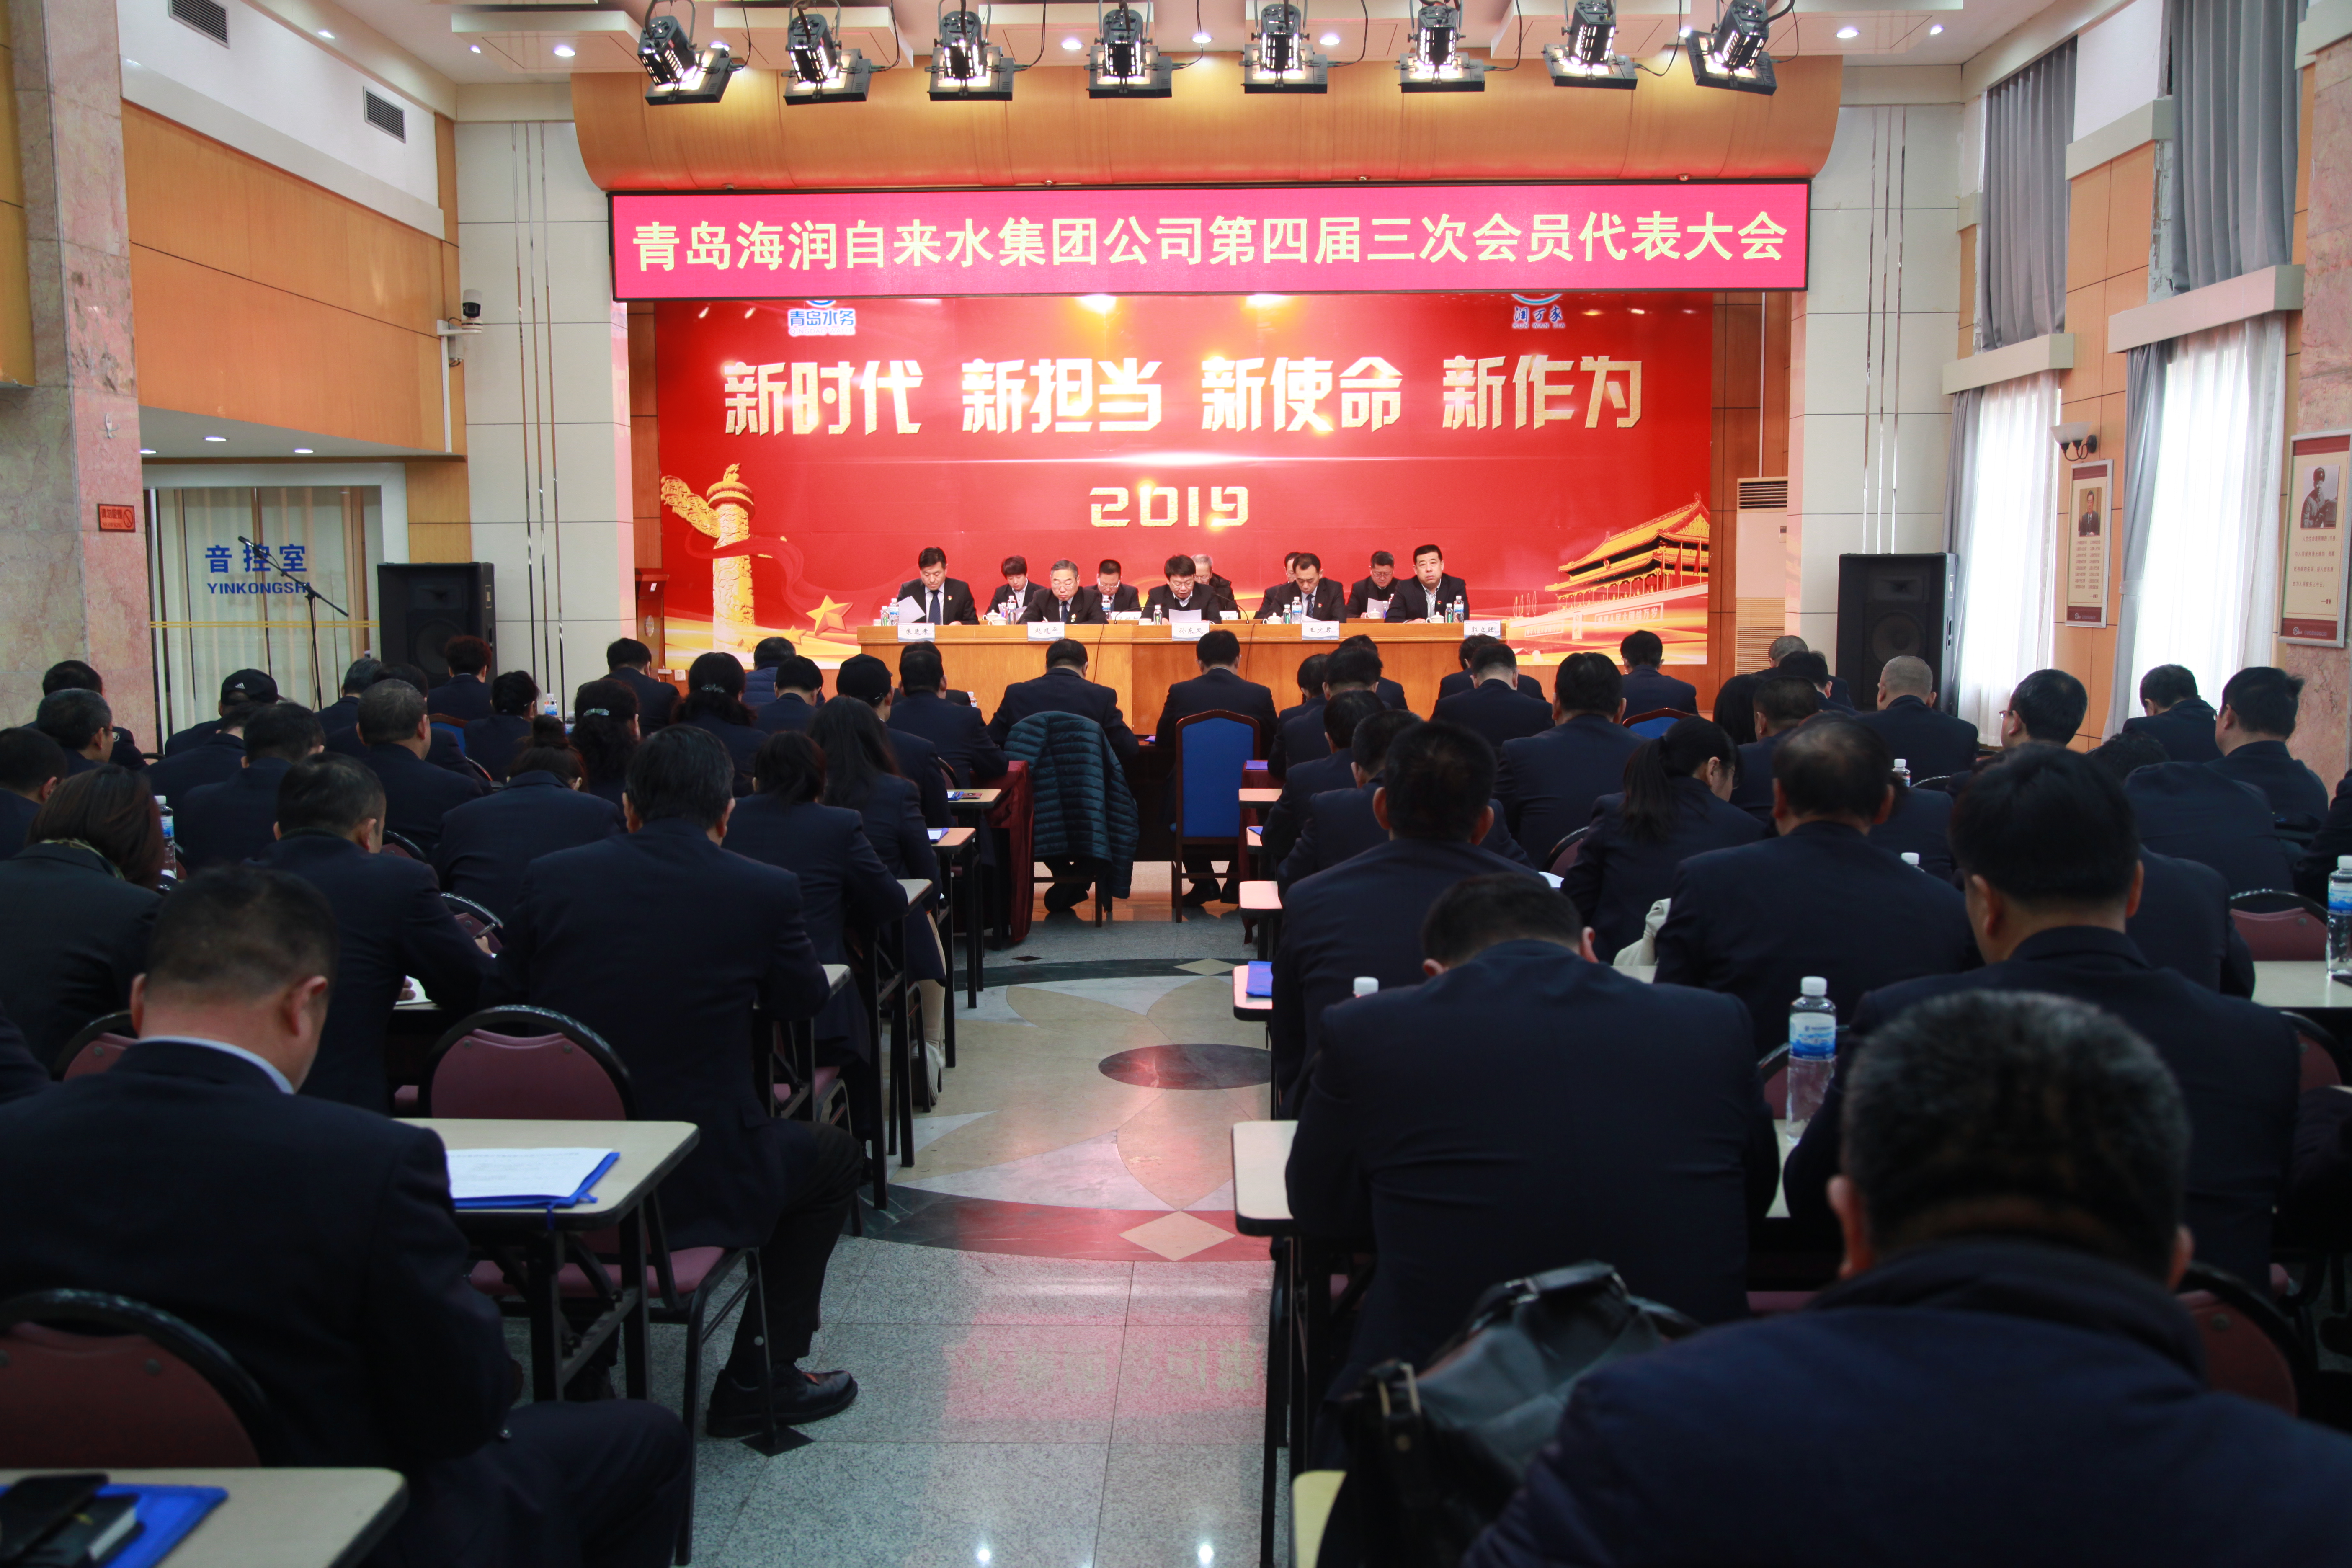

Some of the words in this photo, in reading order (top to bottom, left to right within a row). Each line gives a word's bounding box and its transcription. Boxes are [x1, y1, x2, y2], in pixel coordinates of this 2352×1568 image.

[634, 211, 1787, 271] 青岛海润自来水集团公司第四届三次会员代表大会
[790, 310, 854, 326] 青岛水务
[1515, 306, 1562, 322] 润万家
[724, 358, 923, 436] 新时代
[961, 358, 1163, 435] 新担当
[1201, 356, 1403, 431] 新使命
[1442, 354, 1642, 430] 新作为
[1089, 486, 1250, 528] 2019
[205, 544, 307, 573] 音控室
